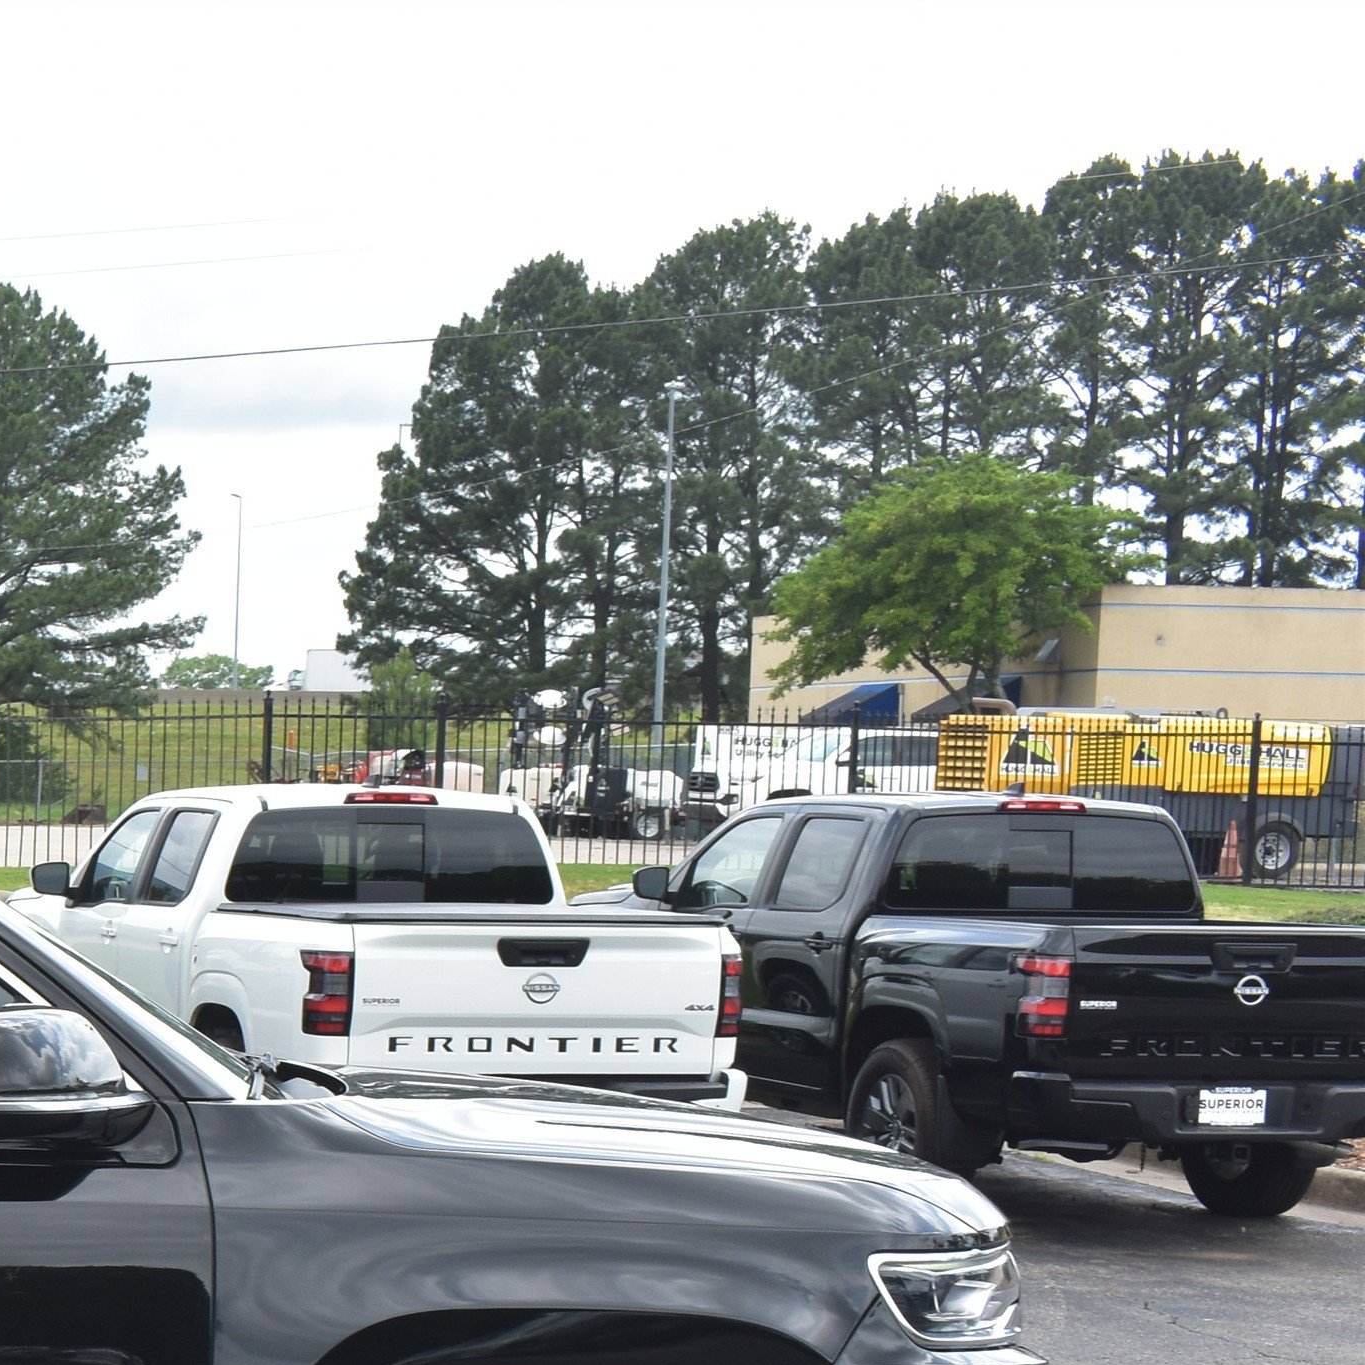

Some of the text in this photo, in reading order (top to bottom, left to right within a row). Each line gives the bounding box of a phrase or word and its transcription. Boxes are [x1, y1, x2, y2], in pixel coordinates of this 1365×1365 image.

[523, 984, 561, 992] NISSAN
[1234, 986, 1268, 995] NISSAN
[388, 1036, 679, 1054] FRONTIER
[1215, 1086, 1253, 1094] SUPERIOR
[1199, 1099, 1264, 1109] SUPERIOR
